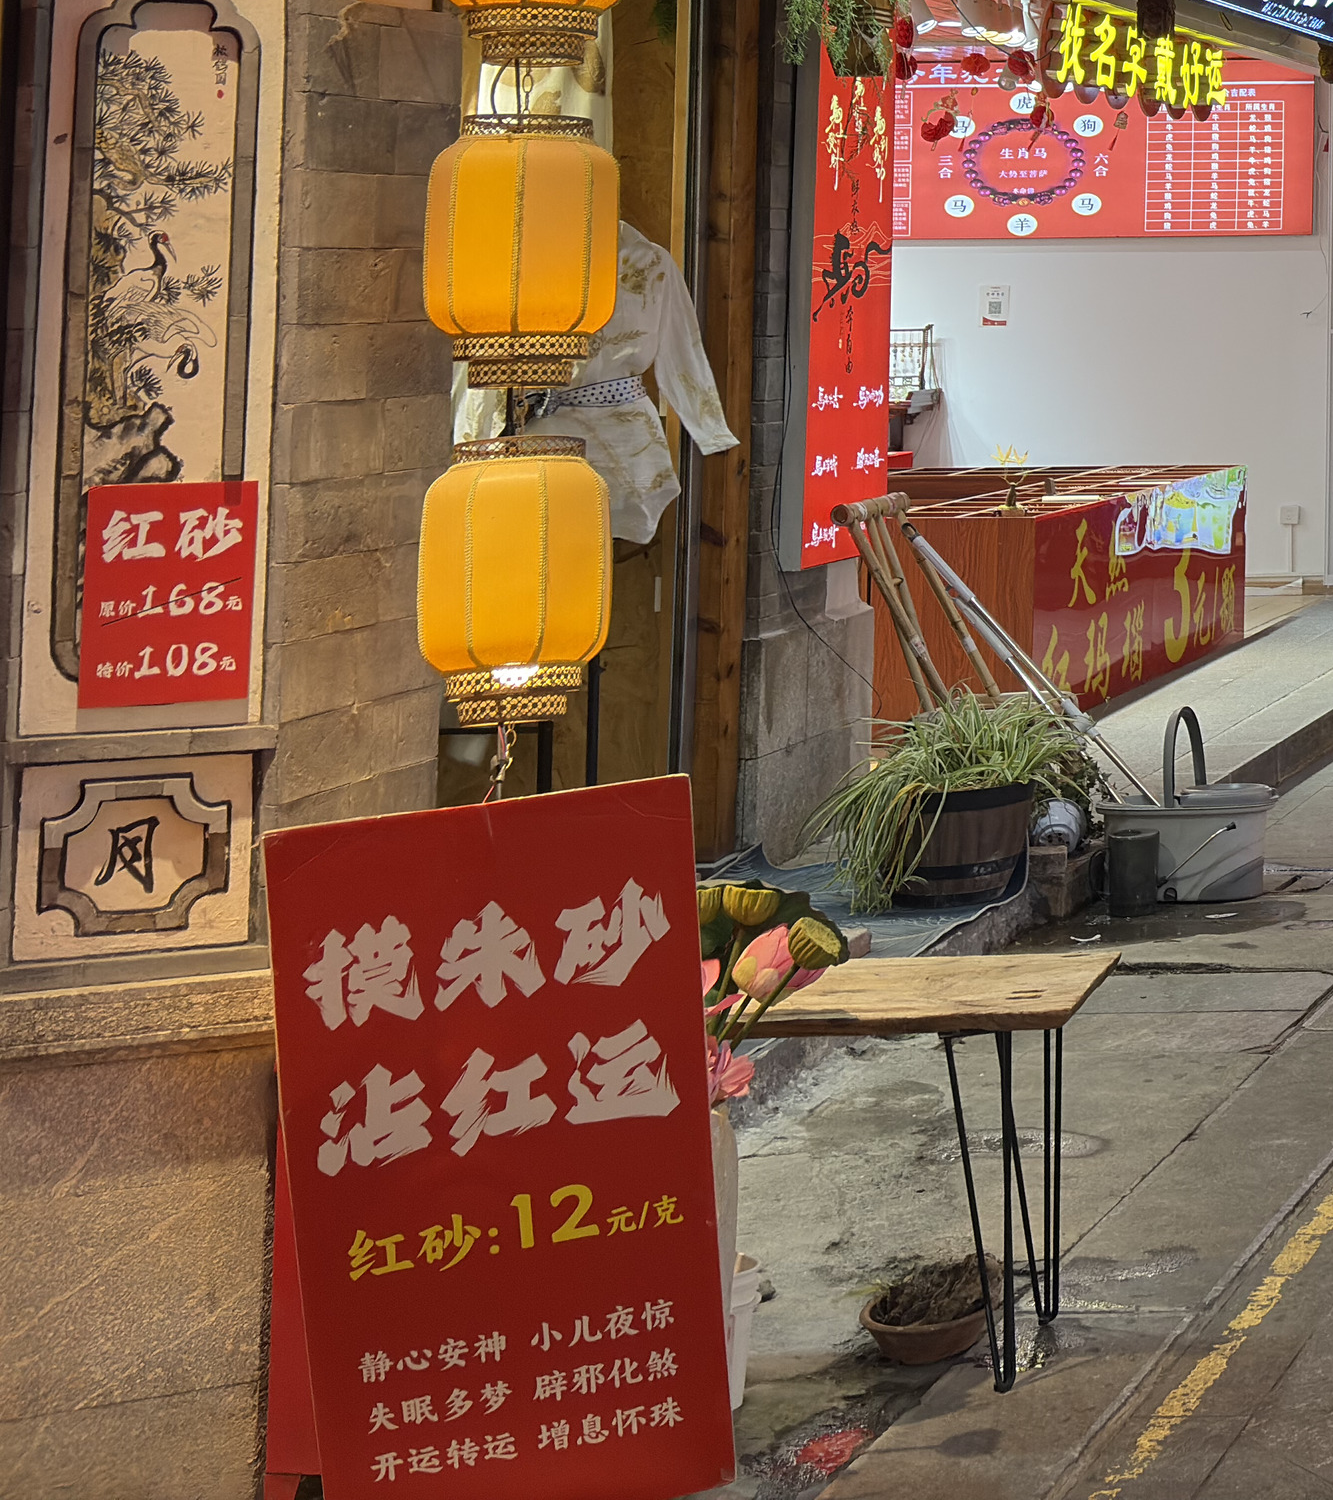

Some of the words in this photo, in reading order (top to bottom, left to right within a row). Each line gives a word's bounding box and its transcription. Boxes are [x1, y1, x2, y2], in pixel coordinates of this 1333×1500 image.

[1056, 3, 1227, 109] 找名字戴好运
[1016, 95, 1033, 110] 虎
[1080, 118, 1097, 133] 狗
[999, 147, 1048, 160] 生肖马
[952, 198, 967, 213] 马
[1014, 217, 1031, 232] 羊
[1078, 197, 1094, 211] 马
[101, 506, 243, 564] 红砂
[96, 641, 237, 680] 特价108元
[94, 815, 160, 893] 月
[303, 876, 671, 1031] 摸朱砂
[316, 1018, 681, 1178] 沾红运
[347, 1183, 685, 1282] 红砂:12元/克
[357, 1330, 508, 1383] 静心安神
[529, 1299, 676, 1352] 小儿夜惊
[367, 1380, 514, 1435] 失眠多梦
[531, 1348, 680, 1404] 辟邪化煞
[370, 1432, 520, 1483] 开运转运
[537, 1398, 686, 1453] 增息怀珠
